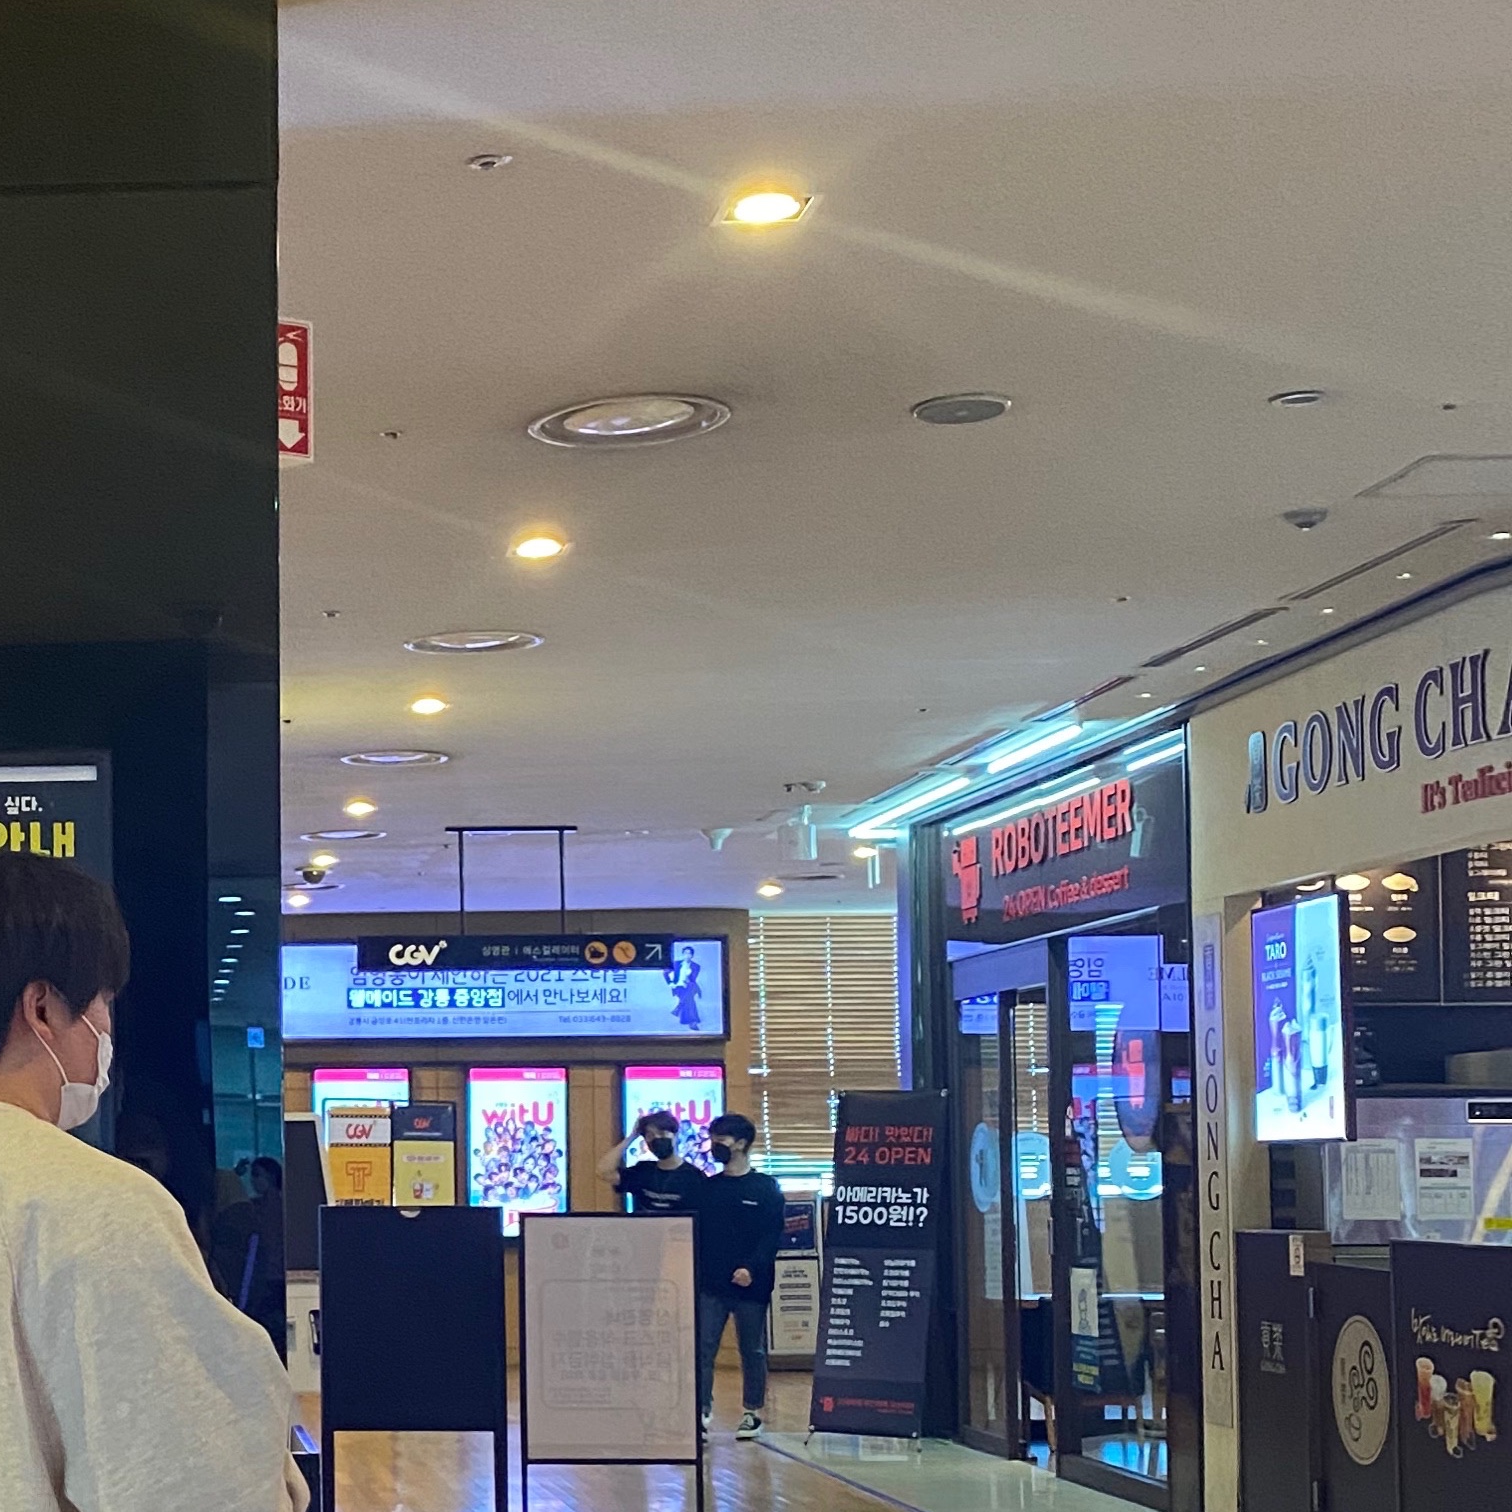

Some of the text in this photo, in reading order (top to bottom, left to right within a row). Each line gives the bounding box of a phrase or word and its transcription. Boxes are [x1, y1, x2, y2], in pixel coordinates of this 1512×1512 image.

[278, 395, 307, 413] 화기
[1272, 682, 1402, 804] GONG
[4, 796, 43, 815] 싶다.
[991, 779, 1134, 877] ROBOTEEMER
[1017, 885, 1046, 914] OPEN
[389, 943, 442, 966] CGV
[482, 945, 580, 957] 상영관 에스컬레이터
[1265, 941, 1287, 961] TARO
[417, 988, 451, 1008] 강릉
[453, 988, 503, 1008] 중앙점
[508, 988, 628, 1006] 에서 만나보세요!
[346, 1122, 374, 1139] CGV
[843, 1146, 933, 1165] 24 OPEN
[836, 1185, 930, 1204] 아메리카노가
[835, 1205, 929, 1228] 1500원!?
